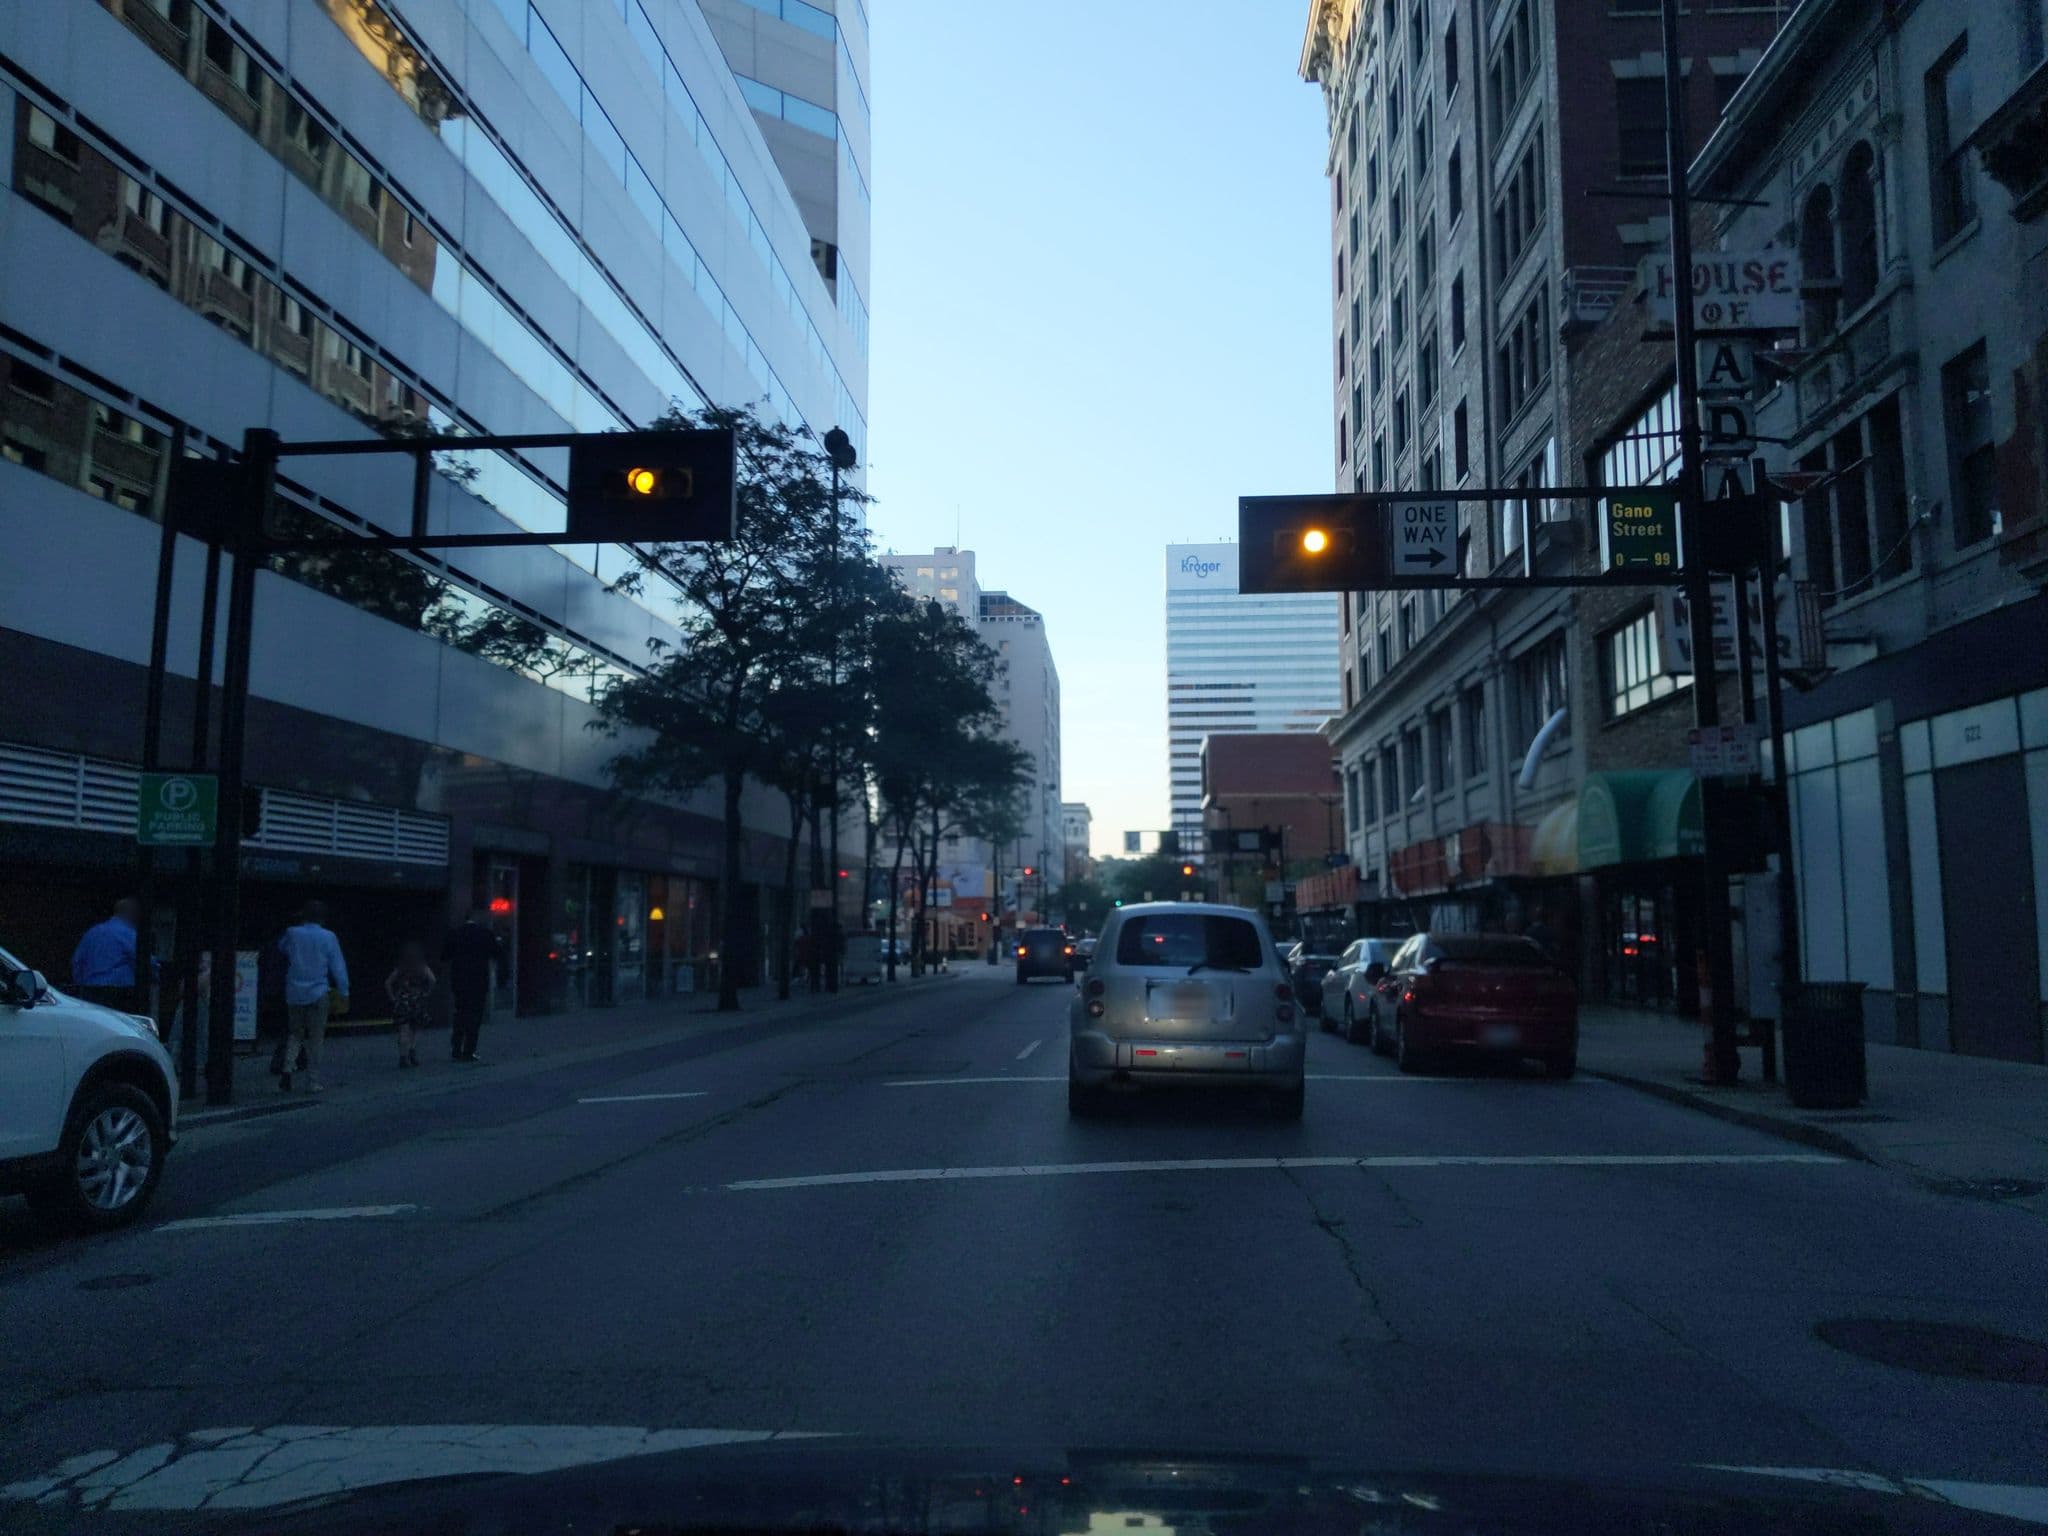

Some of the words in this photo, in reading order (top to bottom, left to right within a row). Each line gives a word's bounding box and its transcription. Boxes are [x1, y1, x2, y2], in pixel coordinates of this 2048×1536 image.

[1656, 260, 1792, 298] HOUSE
[1701, 301, 1748, 324] OF
[1404, 506, 1446, 523] ONE
[1612, 503, 1653, 519] Gano
[1404, 526, 1447, 543] WAY
[1613, 521, 1664, 536] Street
[1181, 555, 1221, 578] Kroger
[1654, 552, 1671, 566] 99
